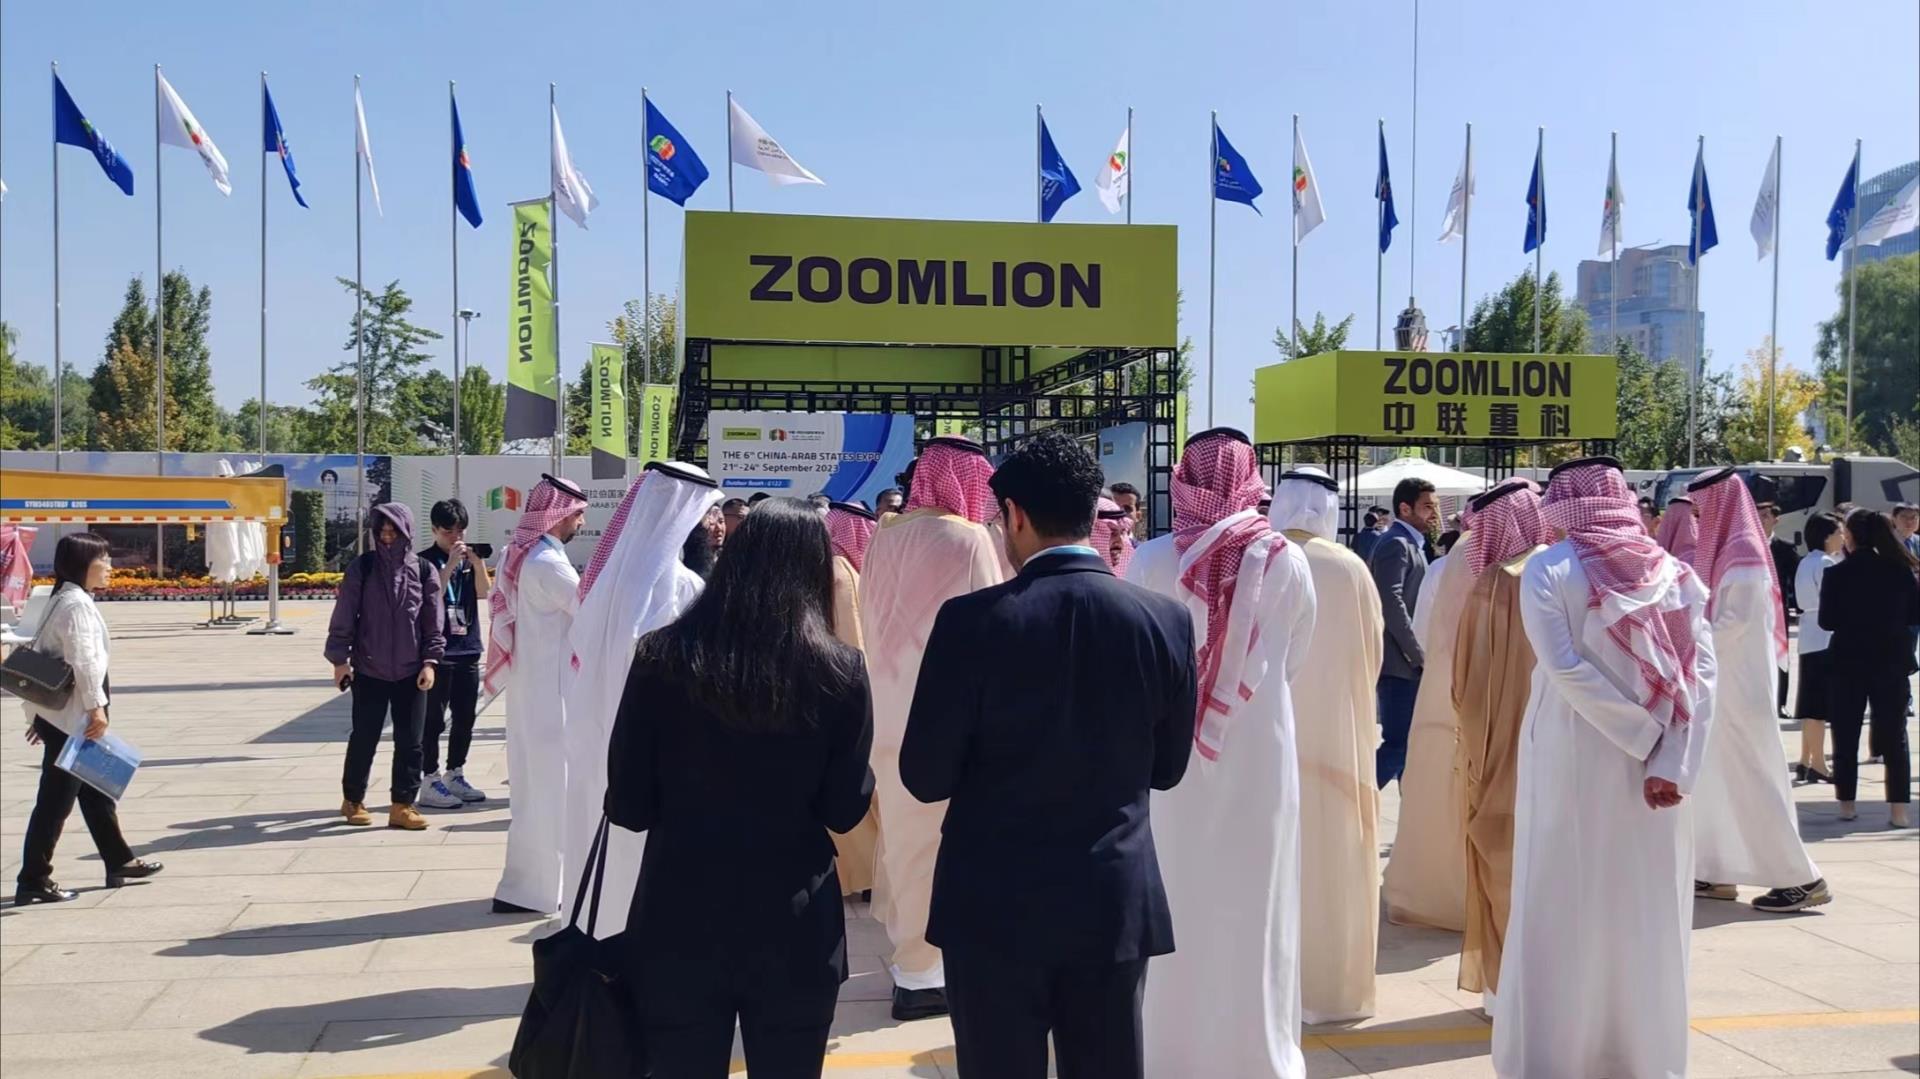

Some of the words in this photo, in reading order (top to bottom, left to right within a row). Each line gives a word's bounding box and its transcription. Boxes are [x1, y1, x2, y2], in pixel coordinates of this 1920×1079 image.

[750, 255, 1101, 308] ZOOMLION
[1384, 358, 1571, 397] ZOOMLION
[650, 395, 661, 458] ZOOMLION
[1384, 402, 1570, 437] 中联重科
[722, 451, 742, 460] THE
[757, 452, 817, 461] CHINA-ARAB
[819, 452, 854, 462] STATES
[856, 453, 881, 462] EXPO
[763, 463, 813, 474] September
[815, 464, 839, 473] 2023
